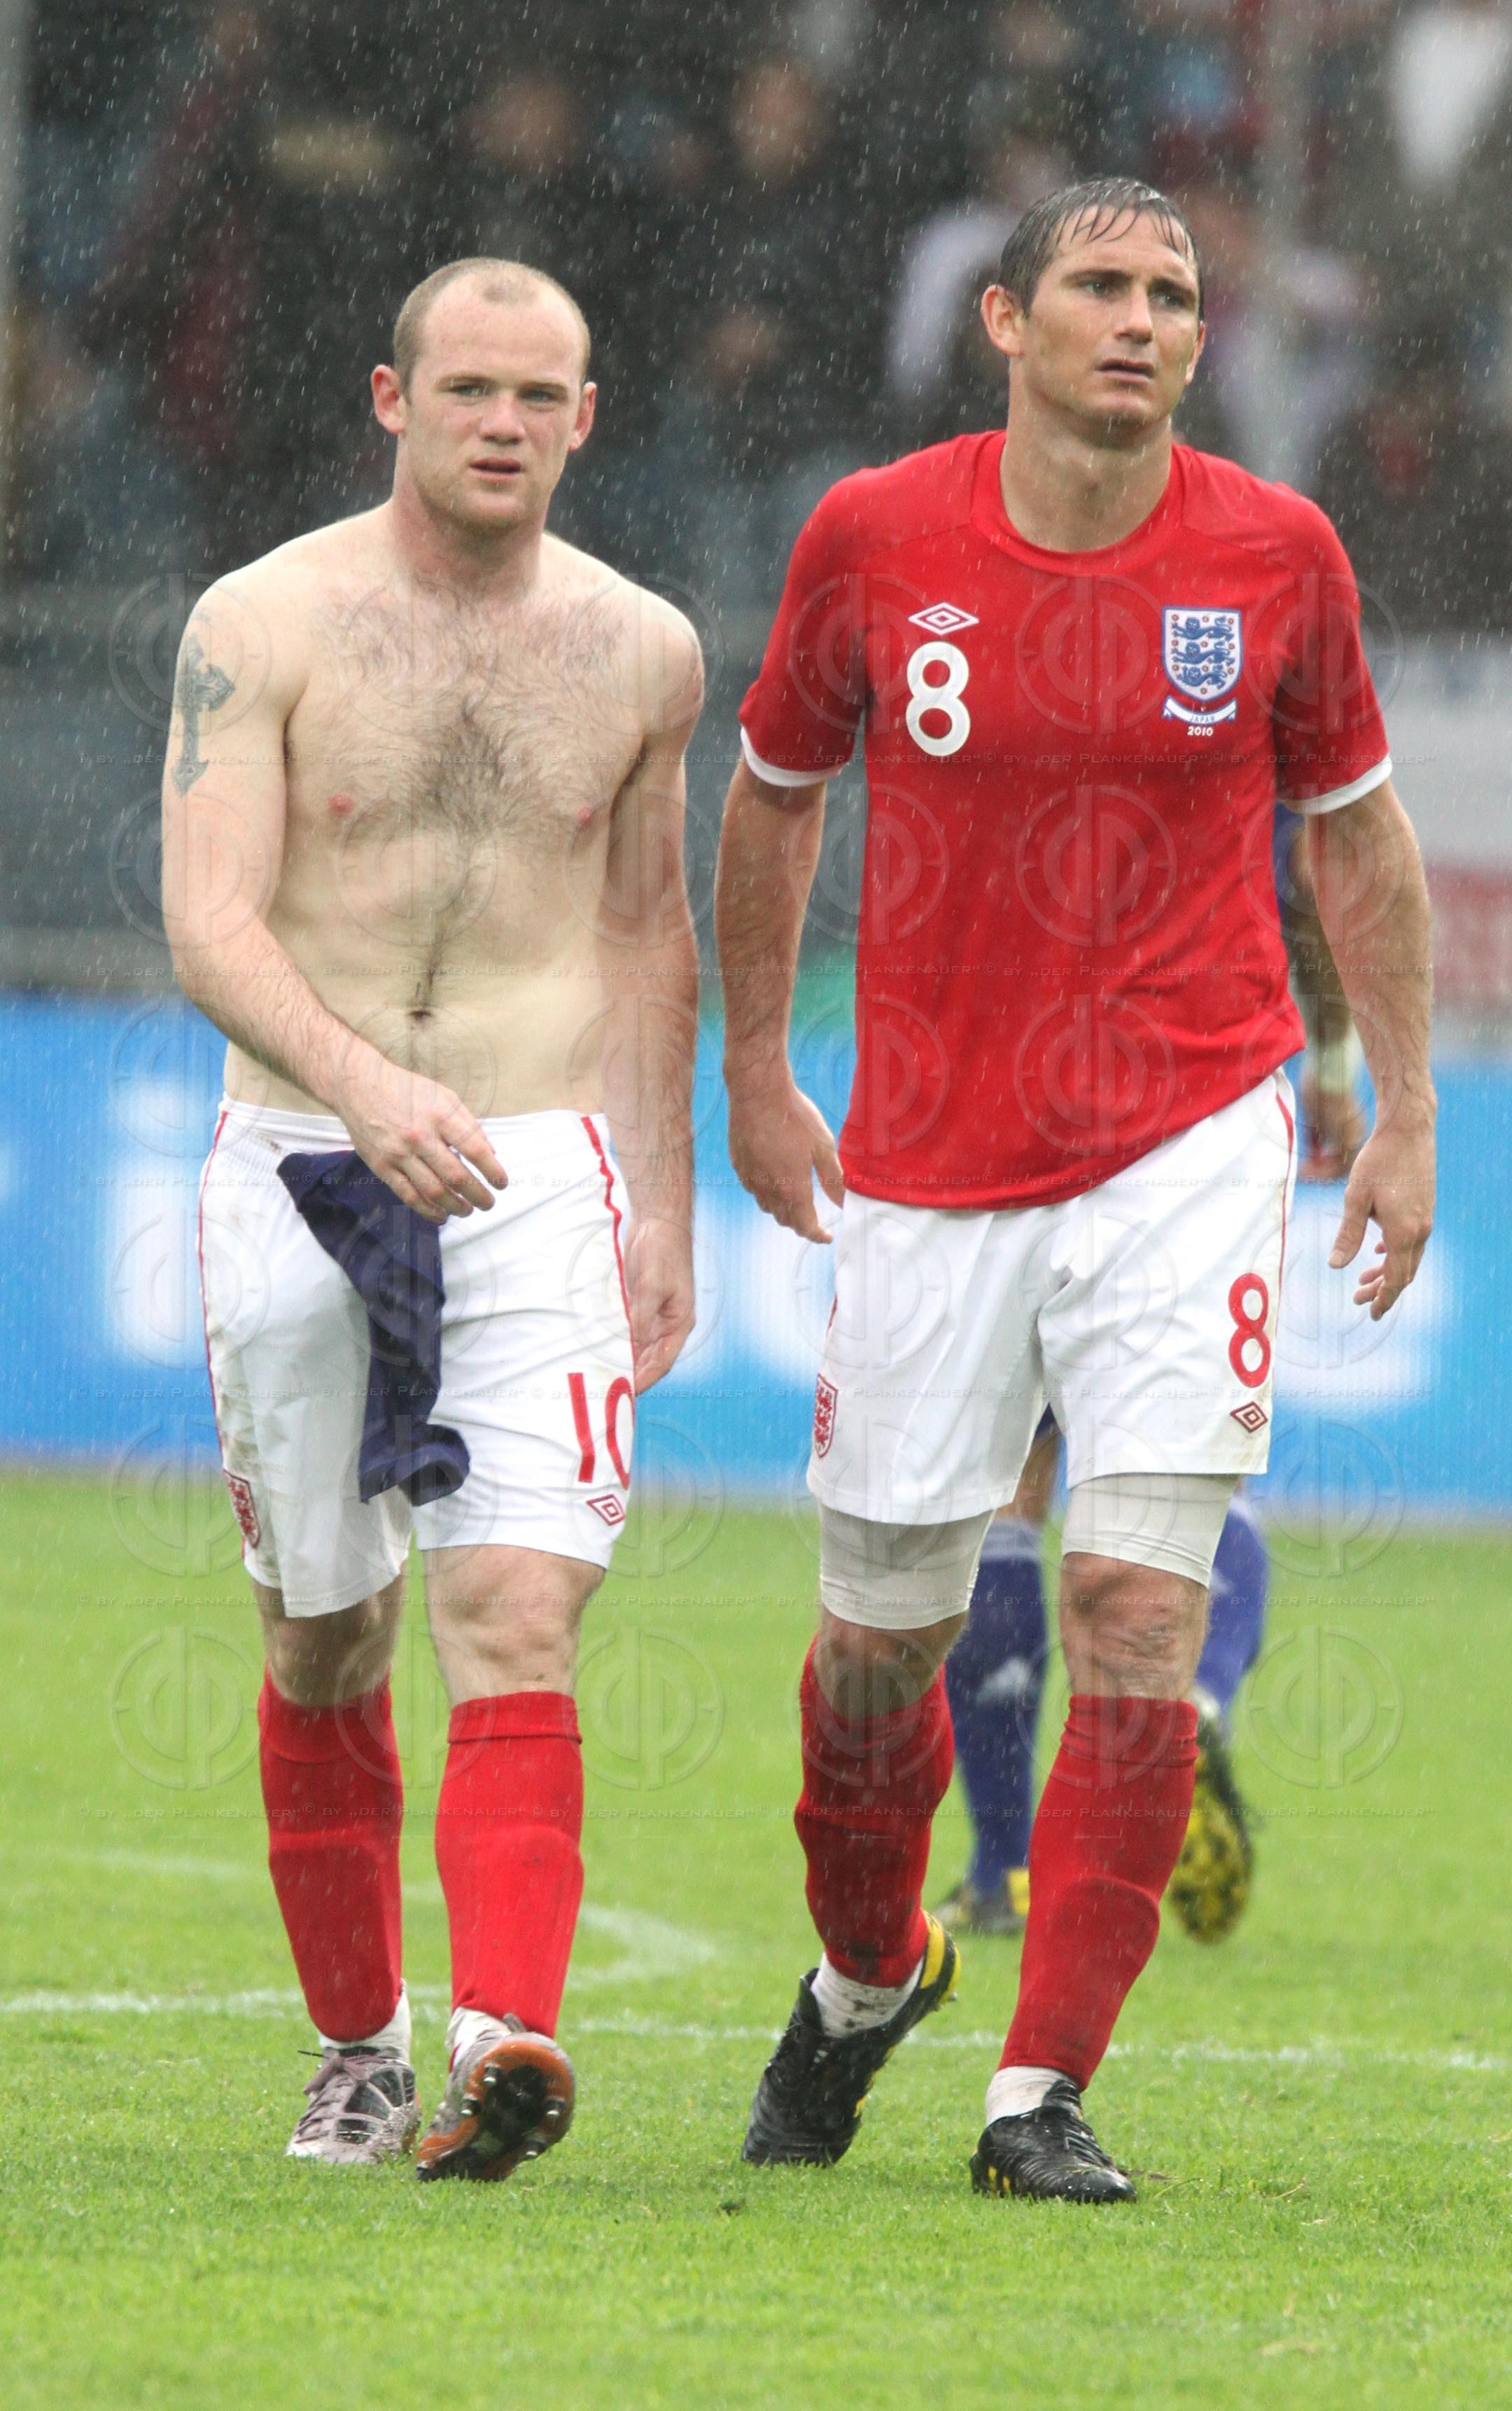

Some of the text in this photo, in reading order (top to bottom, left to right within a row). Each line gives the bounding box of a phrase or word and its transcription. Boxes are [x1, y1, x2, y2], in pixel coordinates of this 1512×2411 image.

[906, 641, 971, 757] 8
[1186, 725, 1214, 737] 2010
[1228, 1273, 1271, 1388] 8
[567, 1372, 635, 1490] 10
